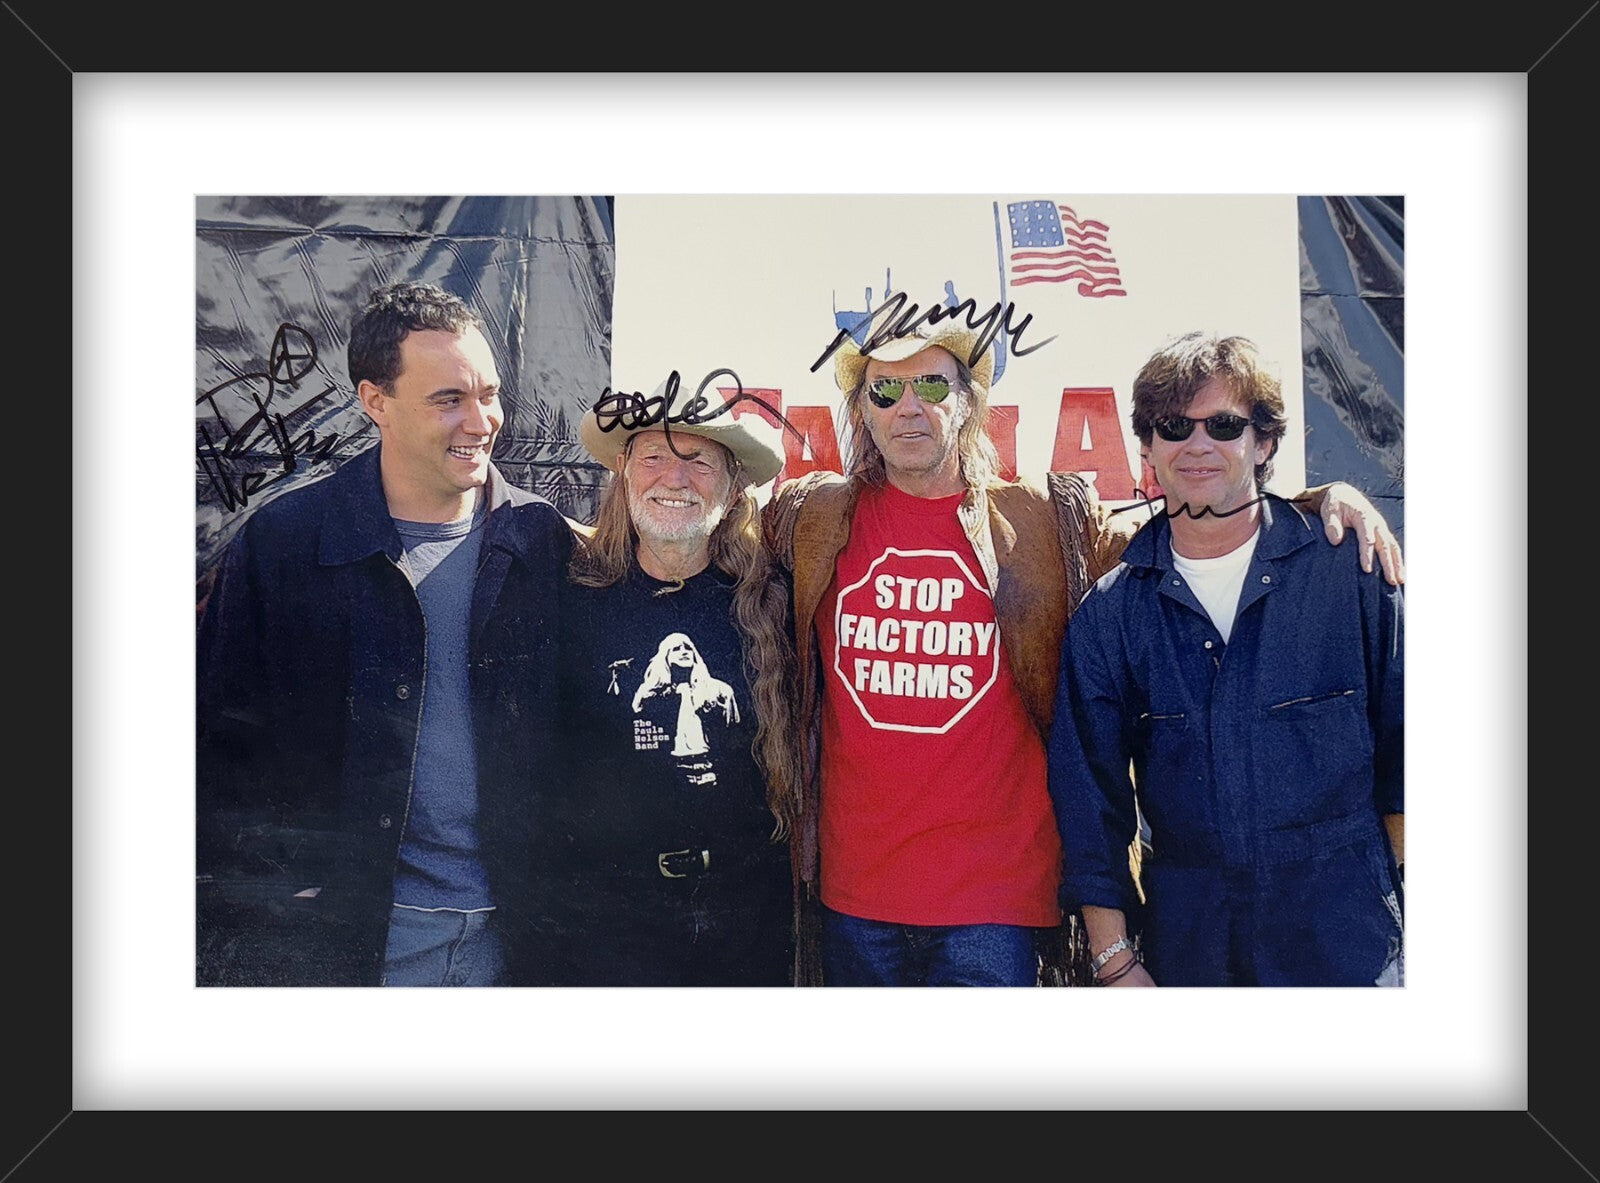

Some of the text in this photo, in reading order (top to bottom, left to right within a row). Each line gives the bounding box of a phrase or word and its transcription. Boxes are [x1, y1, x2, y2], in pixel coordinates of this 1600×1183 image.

[874, 574, 965, 612] STOP
[840, 613, 995, 656] FACTORY
[854, 658, 974, 700] FARMS
[633, 719, 652, 727] The
[634, 726, 664, 735] Paula
[635, 741, 659, 750] Band
